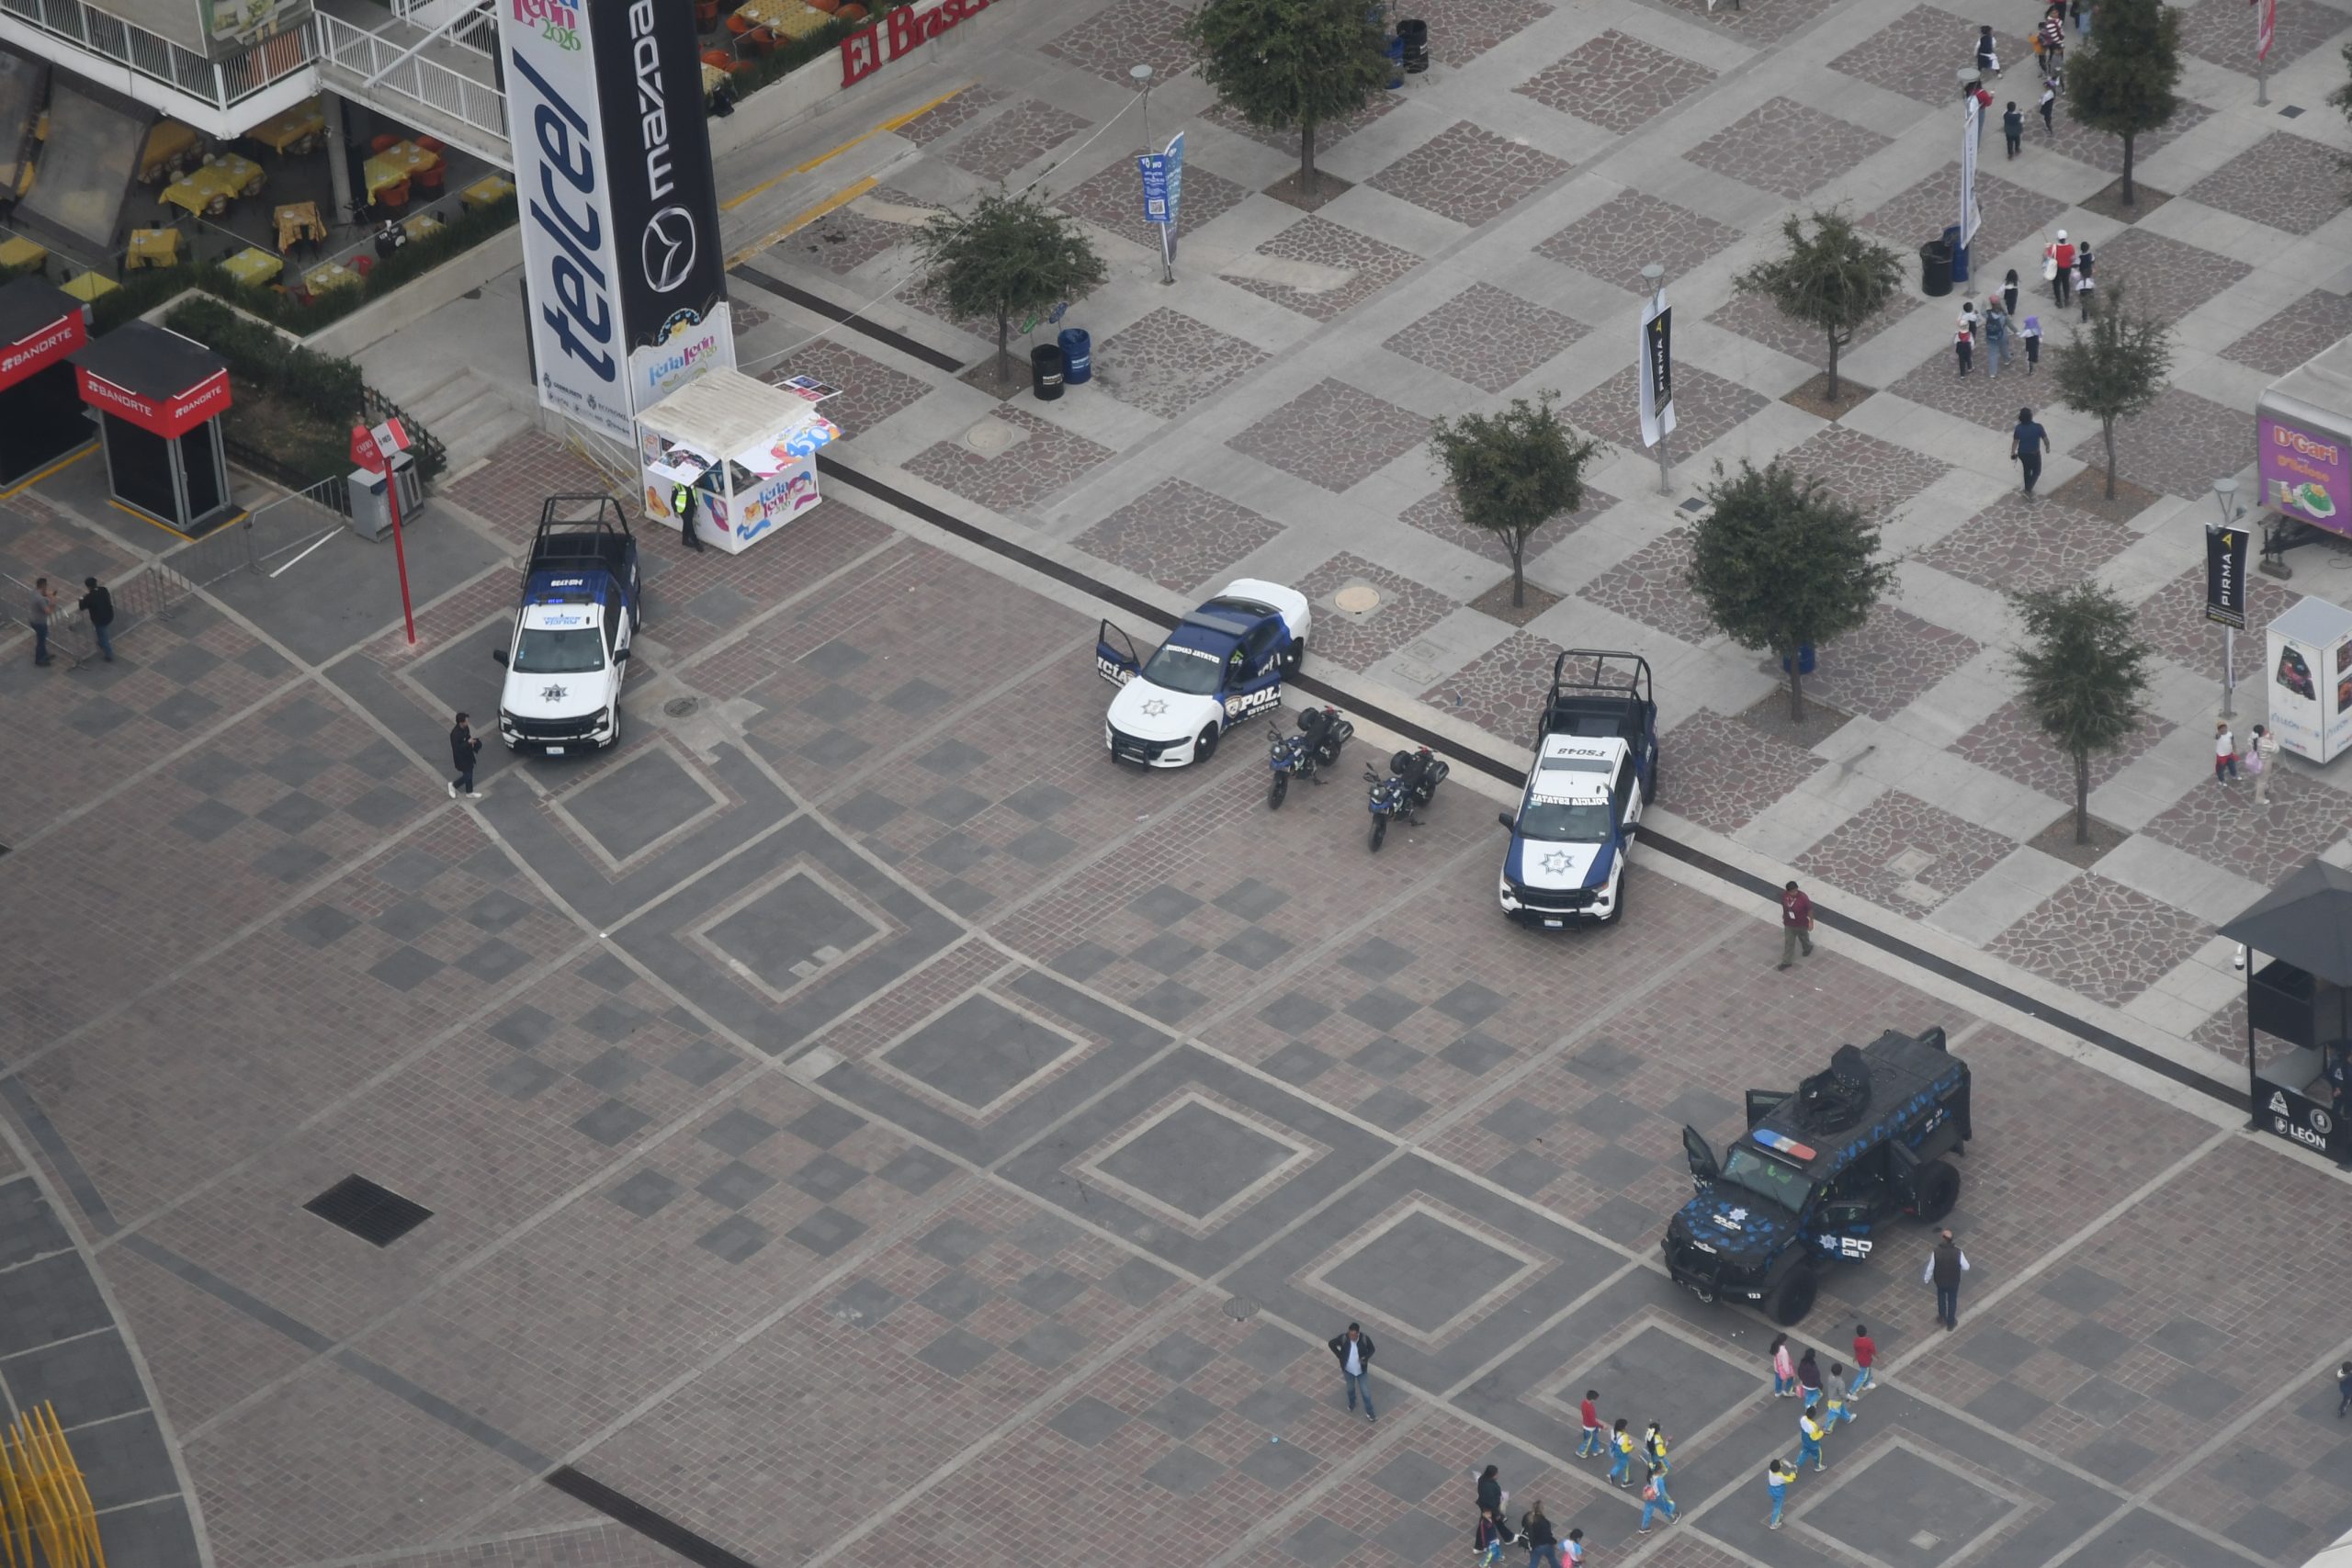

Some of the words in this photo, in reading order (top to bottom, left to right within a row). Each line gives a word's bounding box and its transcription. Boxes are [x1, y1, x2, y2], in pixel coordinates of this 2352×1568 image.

[542, 17, 582, 51] 2026
[839, 22, 882, 89] El
[629, 0, 674, 201] mazda
[512, 47, 616, 383] telcel
[14, 328, 73, 367] BANORTE
[98, 386, 153, 418] BANORTE
[182, 386, 222, 414] BANORTE
[2273, 425, 2339, 466] D'Gari
[2222, 553, 2233, 606] PIRMA
[2290, 1123, 2326, 1149] LEÓN
